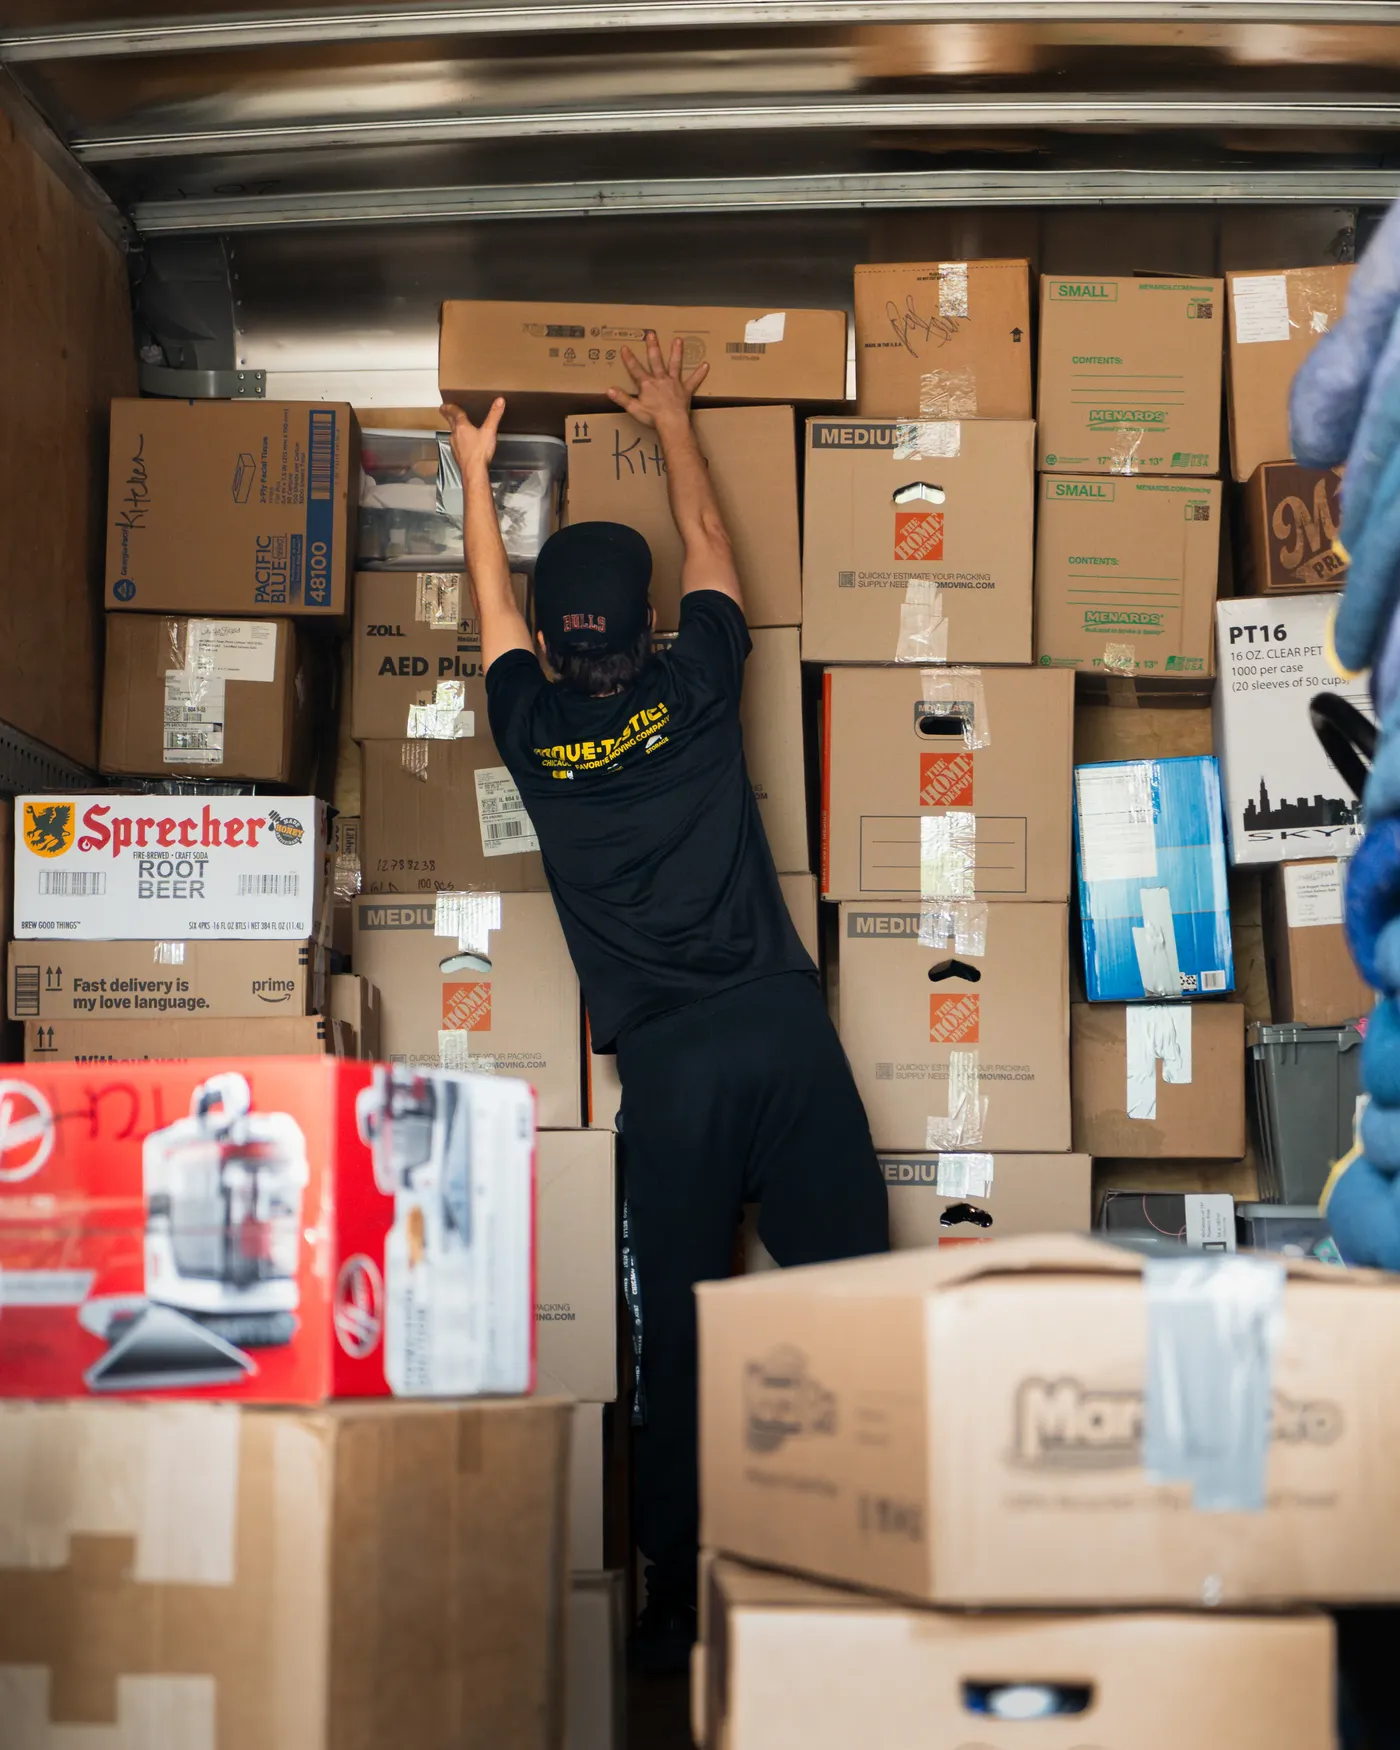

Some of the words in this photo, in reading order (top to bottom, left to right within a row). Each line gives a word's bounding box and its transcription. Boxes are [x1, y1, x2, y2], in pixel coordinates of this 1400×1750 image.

[1058, 285, 1108, 298] SMALL
[1072, 356, 1122, 364] CONTENTS:
[1090, 410, 1166, 422] MENARDS
[260, 461, 268, 482] Facial
[115, 434, 151, 529] Kitchen
[1056, 484, 1106, 497] SMALL
[895, 512, 944, 560] HOME
[900, 518, 920, 536] THE
[914, 530, 944, 560] DEPOT
[255, 536, 271, 604] PACIFIC
[1068, 556, 1119, 566] CONTENTS:
[310, 541, 327, 602] 48100
[858, 572, 891, 580] QUICKLY
[893, 572, 930, 580] ESTIMATE
[956, 573, 990, 581] PACKING
[271, 560, 286, 604] BLUE
[562, 614, 606, 632] BULLS
[1085, 611, 1164, 625] MENARDS
[366, 625, 404, 636] ZOLL
[1229, 624, 1287, 644] PT16
[1231, 652, 1243, 661] 16
[1246, 650, 1264, 660] OZ.
[1266, 648, 1300, 659] CLEAR
[1304, 646, 1323, 656] PET
[378, 656, 429, 676] AED
[1232, 666, 1257, 676] 1000
[1260, 668, 1276, 676] per
[1280, 664, 1303, 673] case
[1232, 681, 1249, 692] (20
[1251, 680, 1289, 690] sleeves
[1292, 678, 1304, 688] of
[1307, 677, 1319, 686] 50
[610, 738, 637, 760] MOVING
[636, 715, 670, 742] COMPANY
[645, 736, 670, 754] STORAGE
[924, 758, 948, 780] THE
[920, 753, 973, 806] HOME
[941, 772, 973, 806] DEPOT
[78, 804, 266, 858] Sprecher
[276, 824, 304, 837] HONEY
[284, 818, 300, 827] MADE
[346, 828, 355, 858] Libbe
[133, 852, 169, 860] FIRE-BREWED
[138, 860, 209, 878] ROOT
[138, 880, 205, 899] BEER
[418, 879, 432, 889] 100
[188, 922, 197, 930] SIX
[198, 922, 210, 930] 4PKS
[220, 922, 226, 930] FL
[228, 922, 234, 930] OZ
[235, 922, 246, 930] BTLS
[251, 922, 260, 930] NET
[261, 922, 270, 930] 384
[272, 922, 277, 930] FL
[278, 922, 285, 930] OZ
[286, 922, 304, 930] (11.4L)
[73, 978, 106, 992] Fast
[109, 978, 172, 995] delivery
[176, 978, 189, 992] is
[252, 980, 295, 994] prime
[73, 998, 96, 1011] my
[100, 995, 131, 1009] love
[134, 996, 210, 1012] language.
[443, 982, 491, 1030] HOME
[447, 988, 466, 1006] THE
[462, 1002, 491, 1030] DEPOT
[935, 998, 955, 1019] THE
[930, 994, 980, 1042] HOME
[949, 1012, 979, 1042] DEPOT
[896, 1064, 929, 1072] QUICKLY
[896, 1072, 926, 1080] SUPPLY
